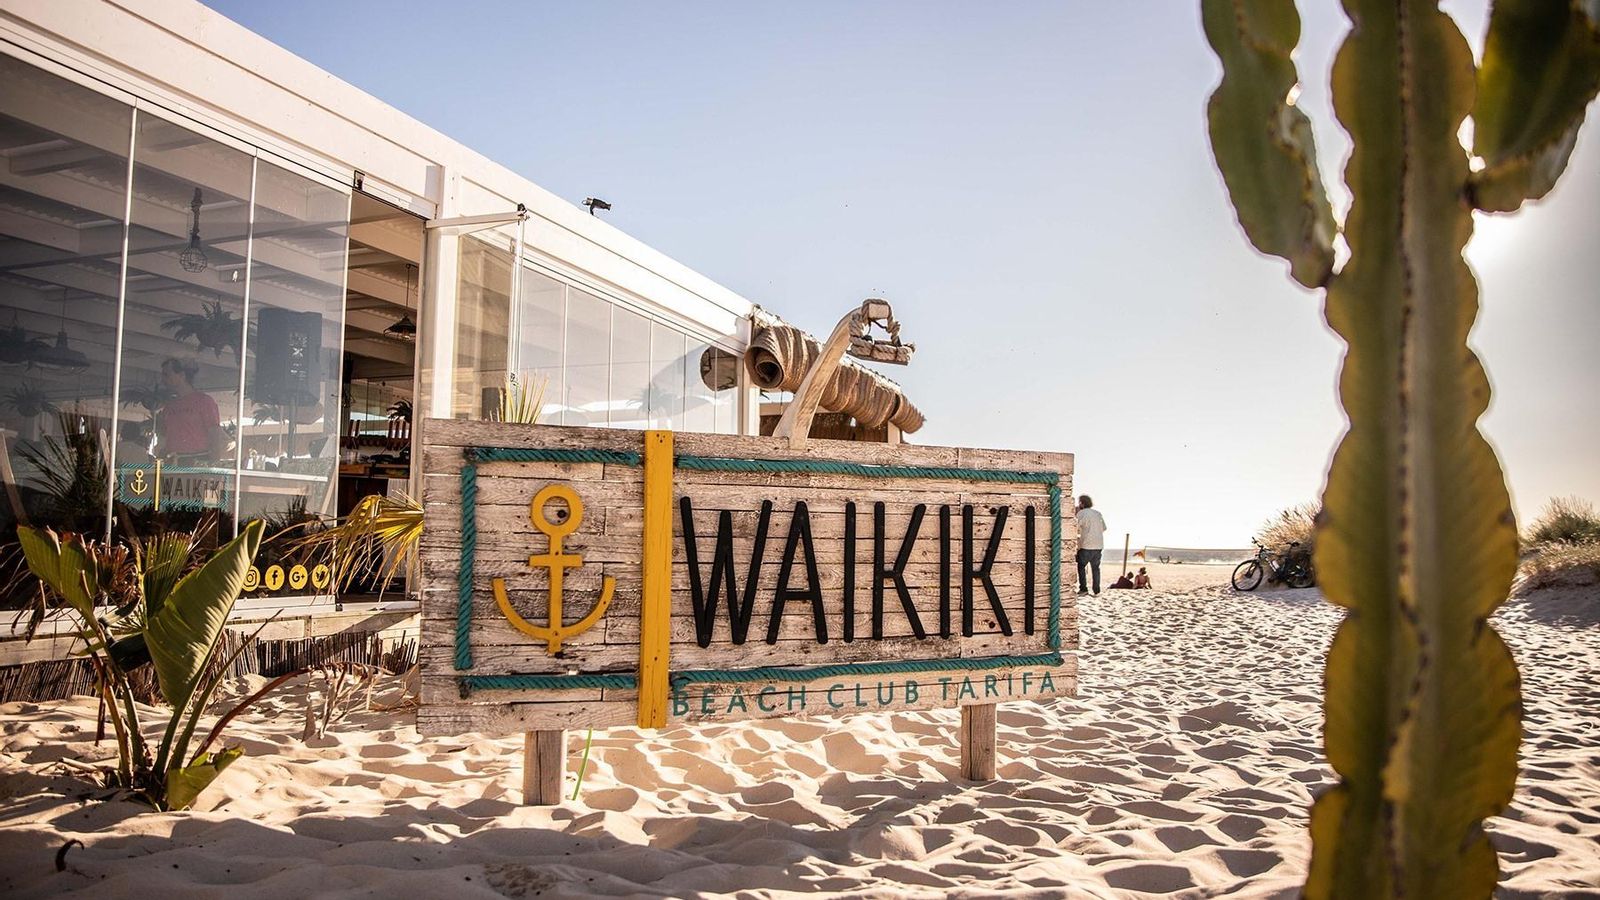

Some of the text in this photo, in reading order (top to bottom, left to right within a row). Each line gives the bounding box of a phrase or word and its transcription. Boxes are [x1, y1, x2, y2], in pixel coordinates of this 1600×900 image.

[160, 476, 224, 499] WAIKIK
[680, 496, 1035, 648] WAIKIKI
[673, 671, 1056, 717] BEACH CLUB TARIFA
